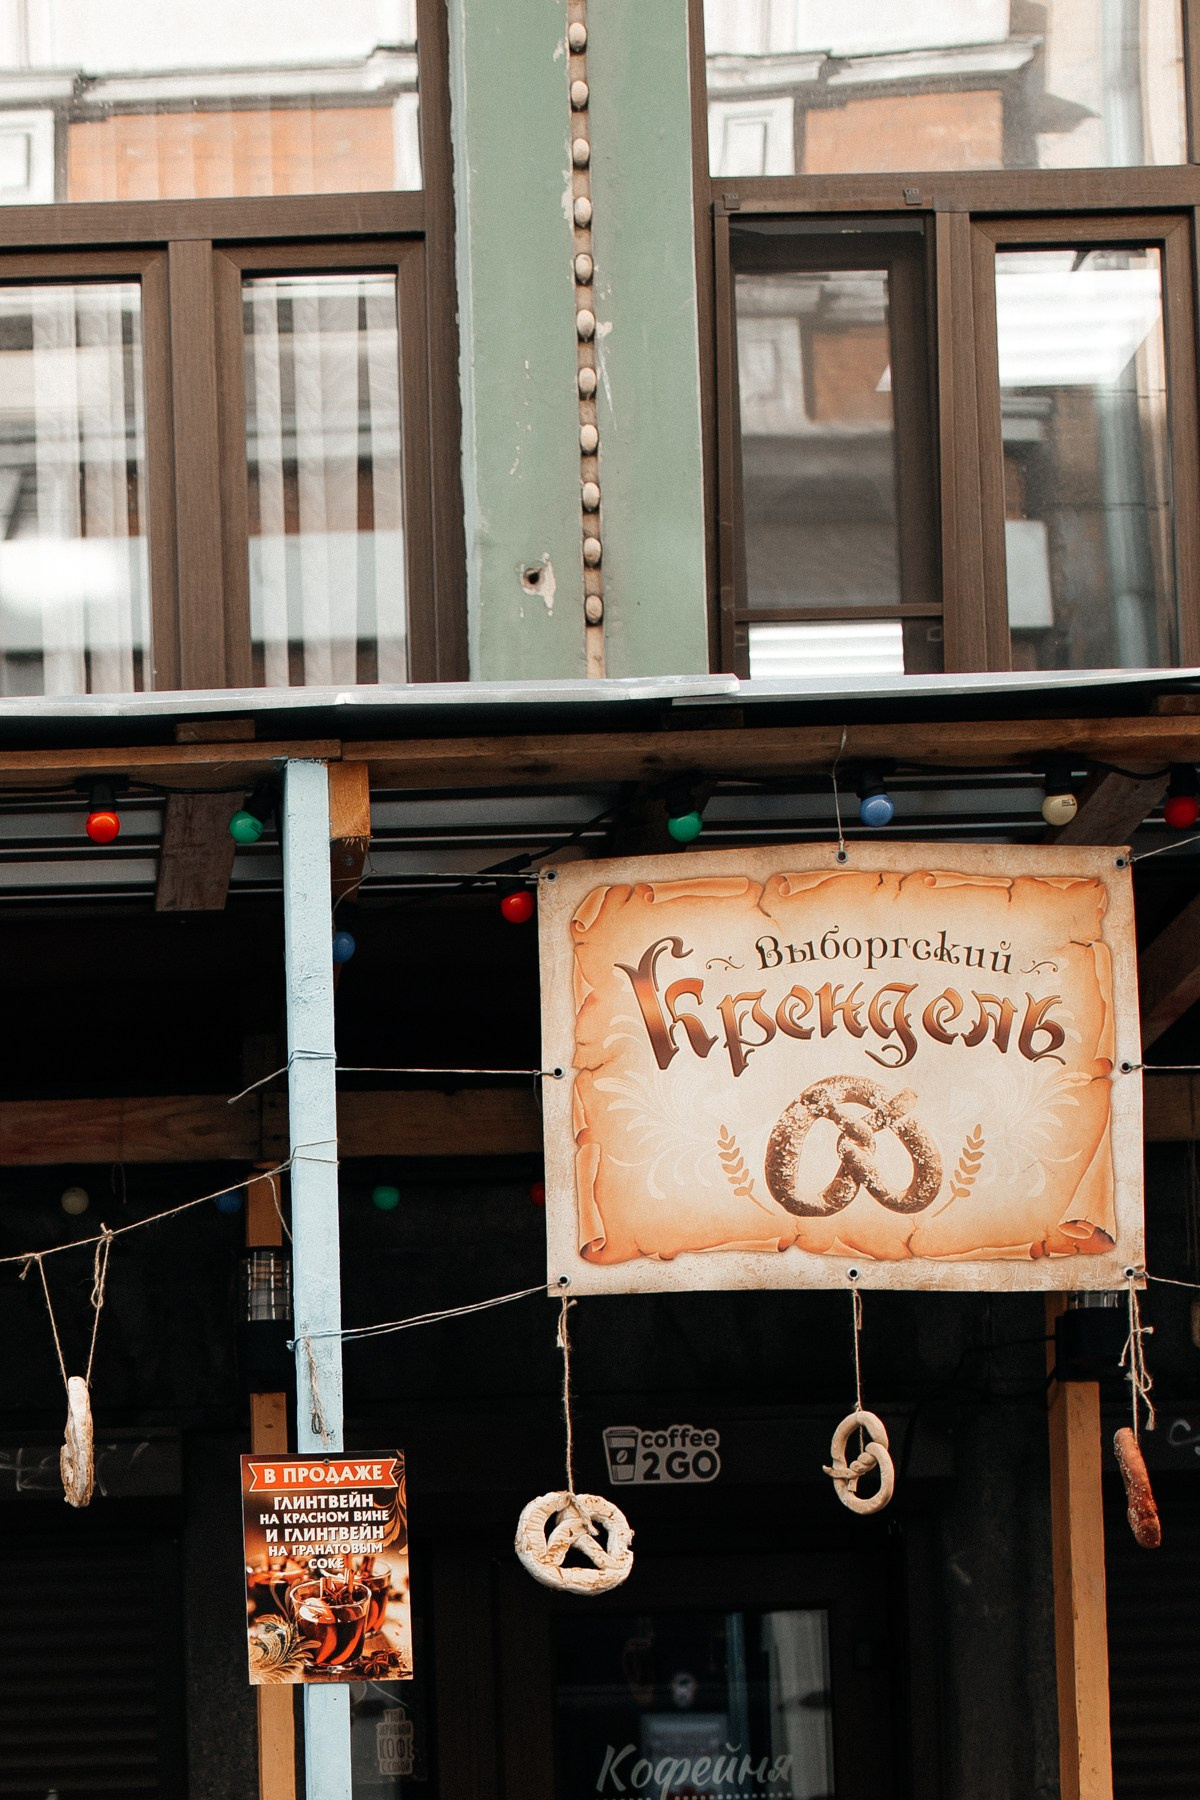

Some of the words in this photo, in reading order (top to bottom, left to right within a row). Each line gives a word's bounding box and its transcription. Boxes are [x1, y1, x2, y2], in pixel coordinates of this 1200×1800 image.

[755, 925, 1013, 975] Выборгский
[614, 934, 1067, 1077] Крендель
[641, 1428, 717, 1448] coffee
[264, 1468, 276, 1484] В
[283, 1465, 383, 1484] ПРОДАЖЕ
[274, 1492, 374, 1510] ГЛИНТВЕЙН
[260, 1514, 279, 1525] НА
[283, 1511, 349, 1524] КРАСНОМ
[354, 1510, 389, 1522] ВИНЕ
[266, 1529, 278, 1543] И
[284, 1524, 384, 1542] ГЛИНТВЕЙН
[268, 1546, 288, 1557] НА
[292, 1543, 383, 1556] ГРАНАТОВЫМ
[308, 1558, 345, 1569] СОКЕ
